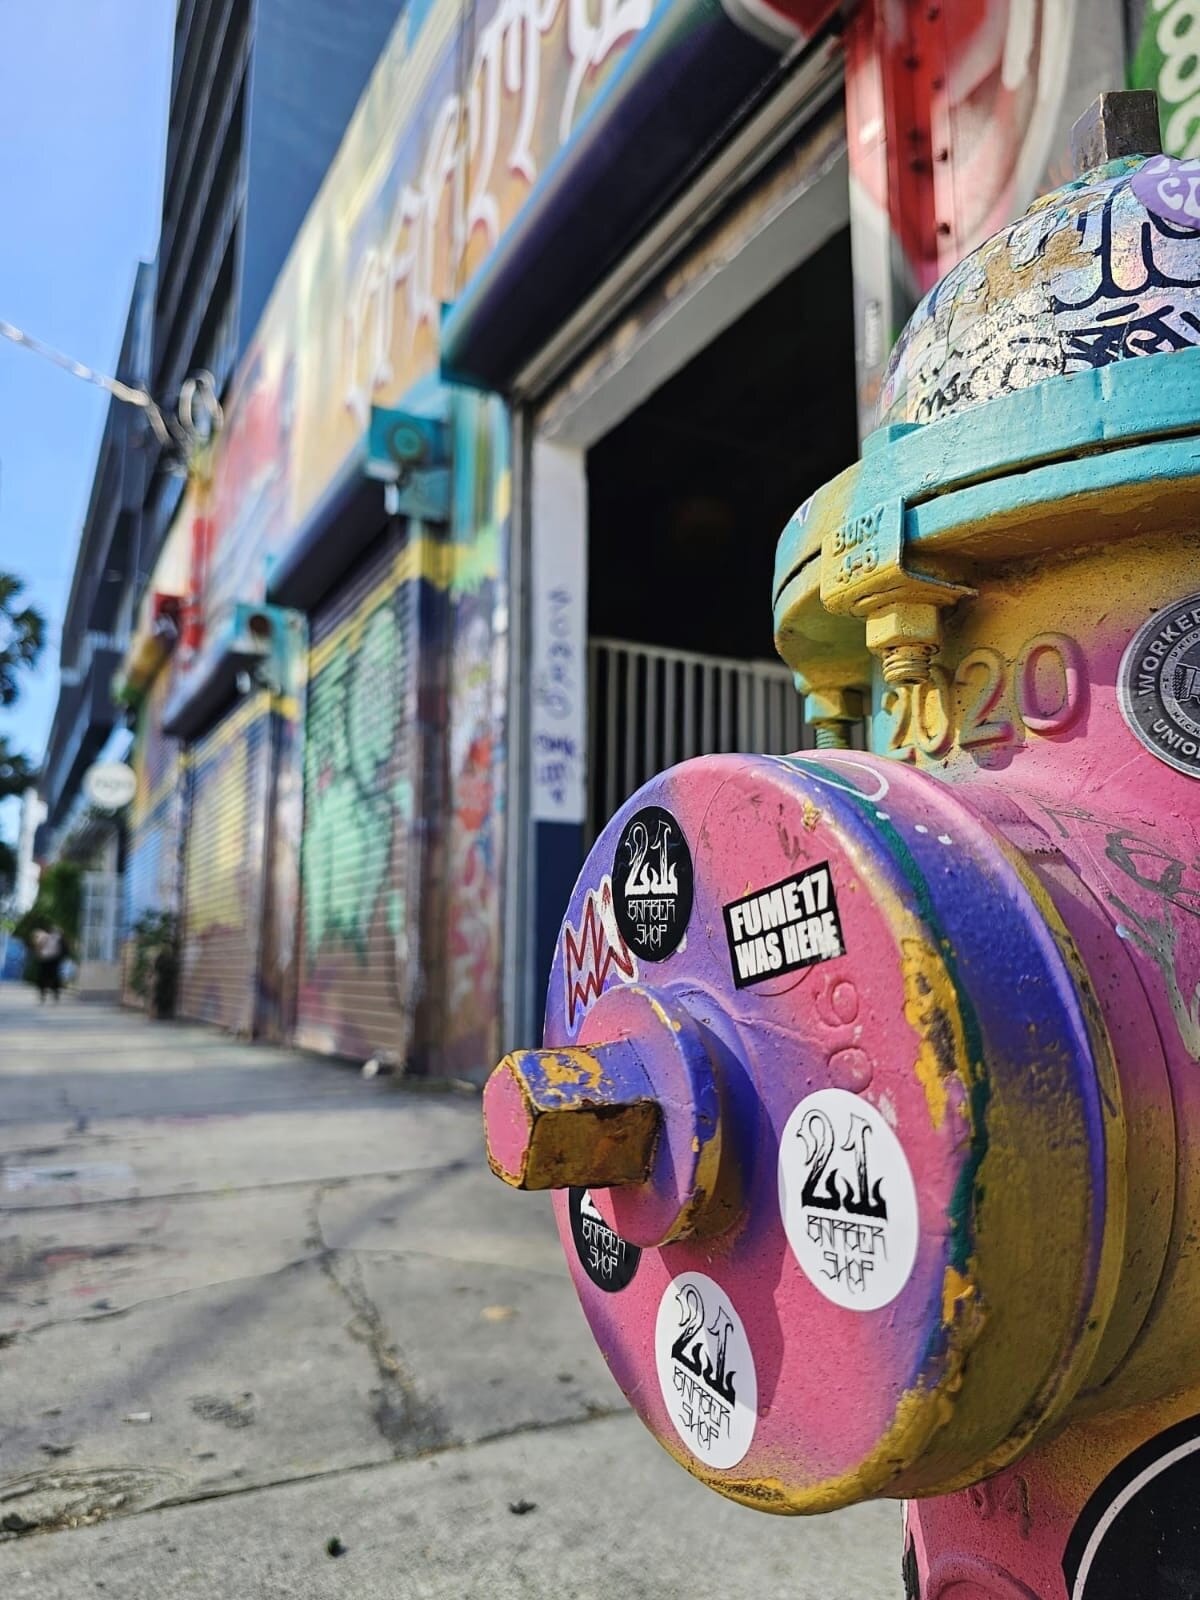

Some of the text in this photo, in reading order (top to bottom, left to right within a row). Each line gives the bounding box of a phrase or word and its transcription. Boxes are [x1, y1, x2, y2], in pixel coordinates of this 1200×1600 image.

[832, 504, 885, 557] BURY
[880, 631, 1091, 762] 2020
[1152, 718, 1200, 760] UNIO
[624, 820, 679, 898] 21
[627, 898, 676, 923] BARBER
[633, 923, 668, 951] SHOP
[734, 910, 842, 980] WAS HERE
[796, 1108, 889, 1221] 21
[588, 1245, 618, 1280] SHOP
[806, 1214, 889, 1262] BARBER
[819, 1250, 875, 1295] SHOP
[670, 1283, 737, 1410] 21
[672, 1364, 731, 1439] BARBER
[678, 1400, 720, 1451] SHOP
